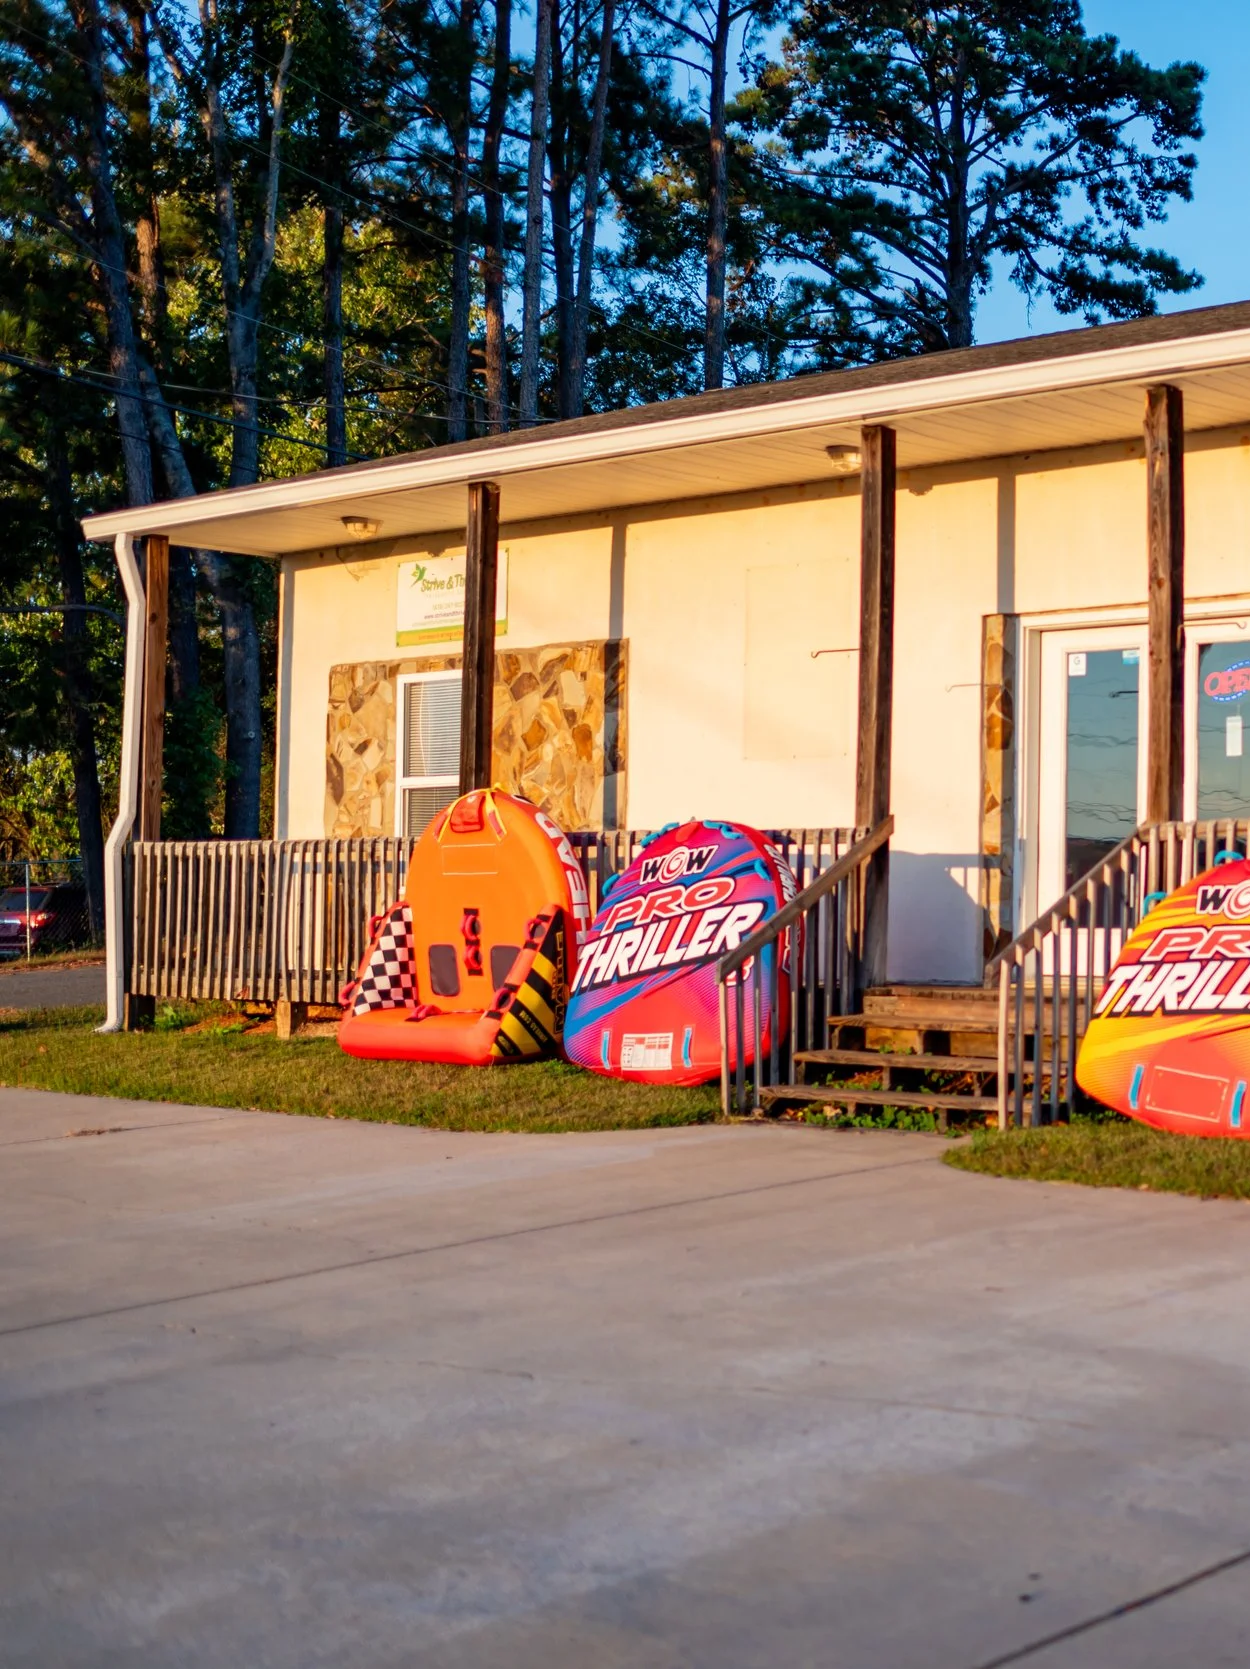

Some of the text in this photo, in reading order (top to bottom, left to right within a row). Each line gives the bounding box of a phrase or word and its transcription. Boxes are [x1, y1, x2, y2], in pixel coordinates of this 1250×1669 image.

[421, 573, 465, 592] Strive & Th
[535, 811, 590, 955] HEAD
[640, 845, 719, 885] WOW
[600, 877, 735, 936] PRO
[570, 902, 764, 993] THRILLER
